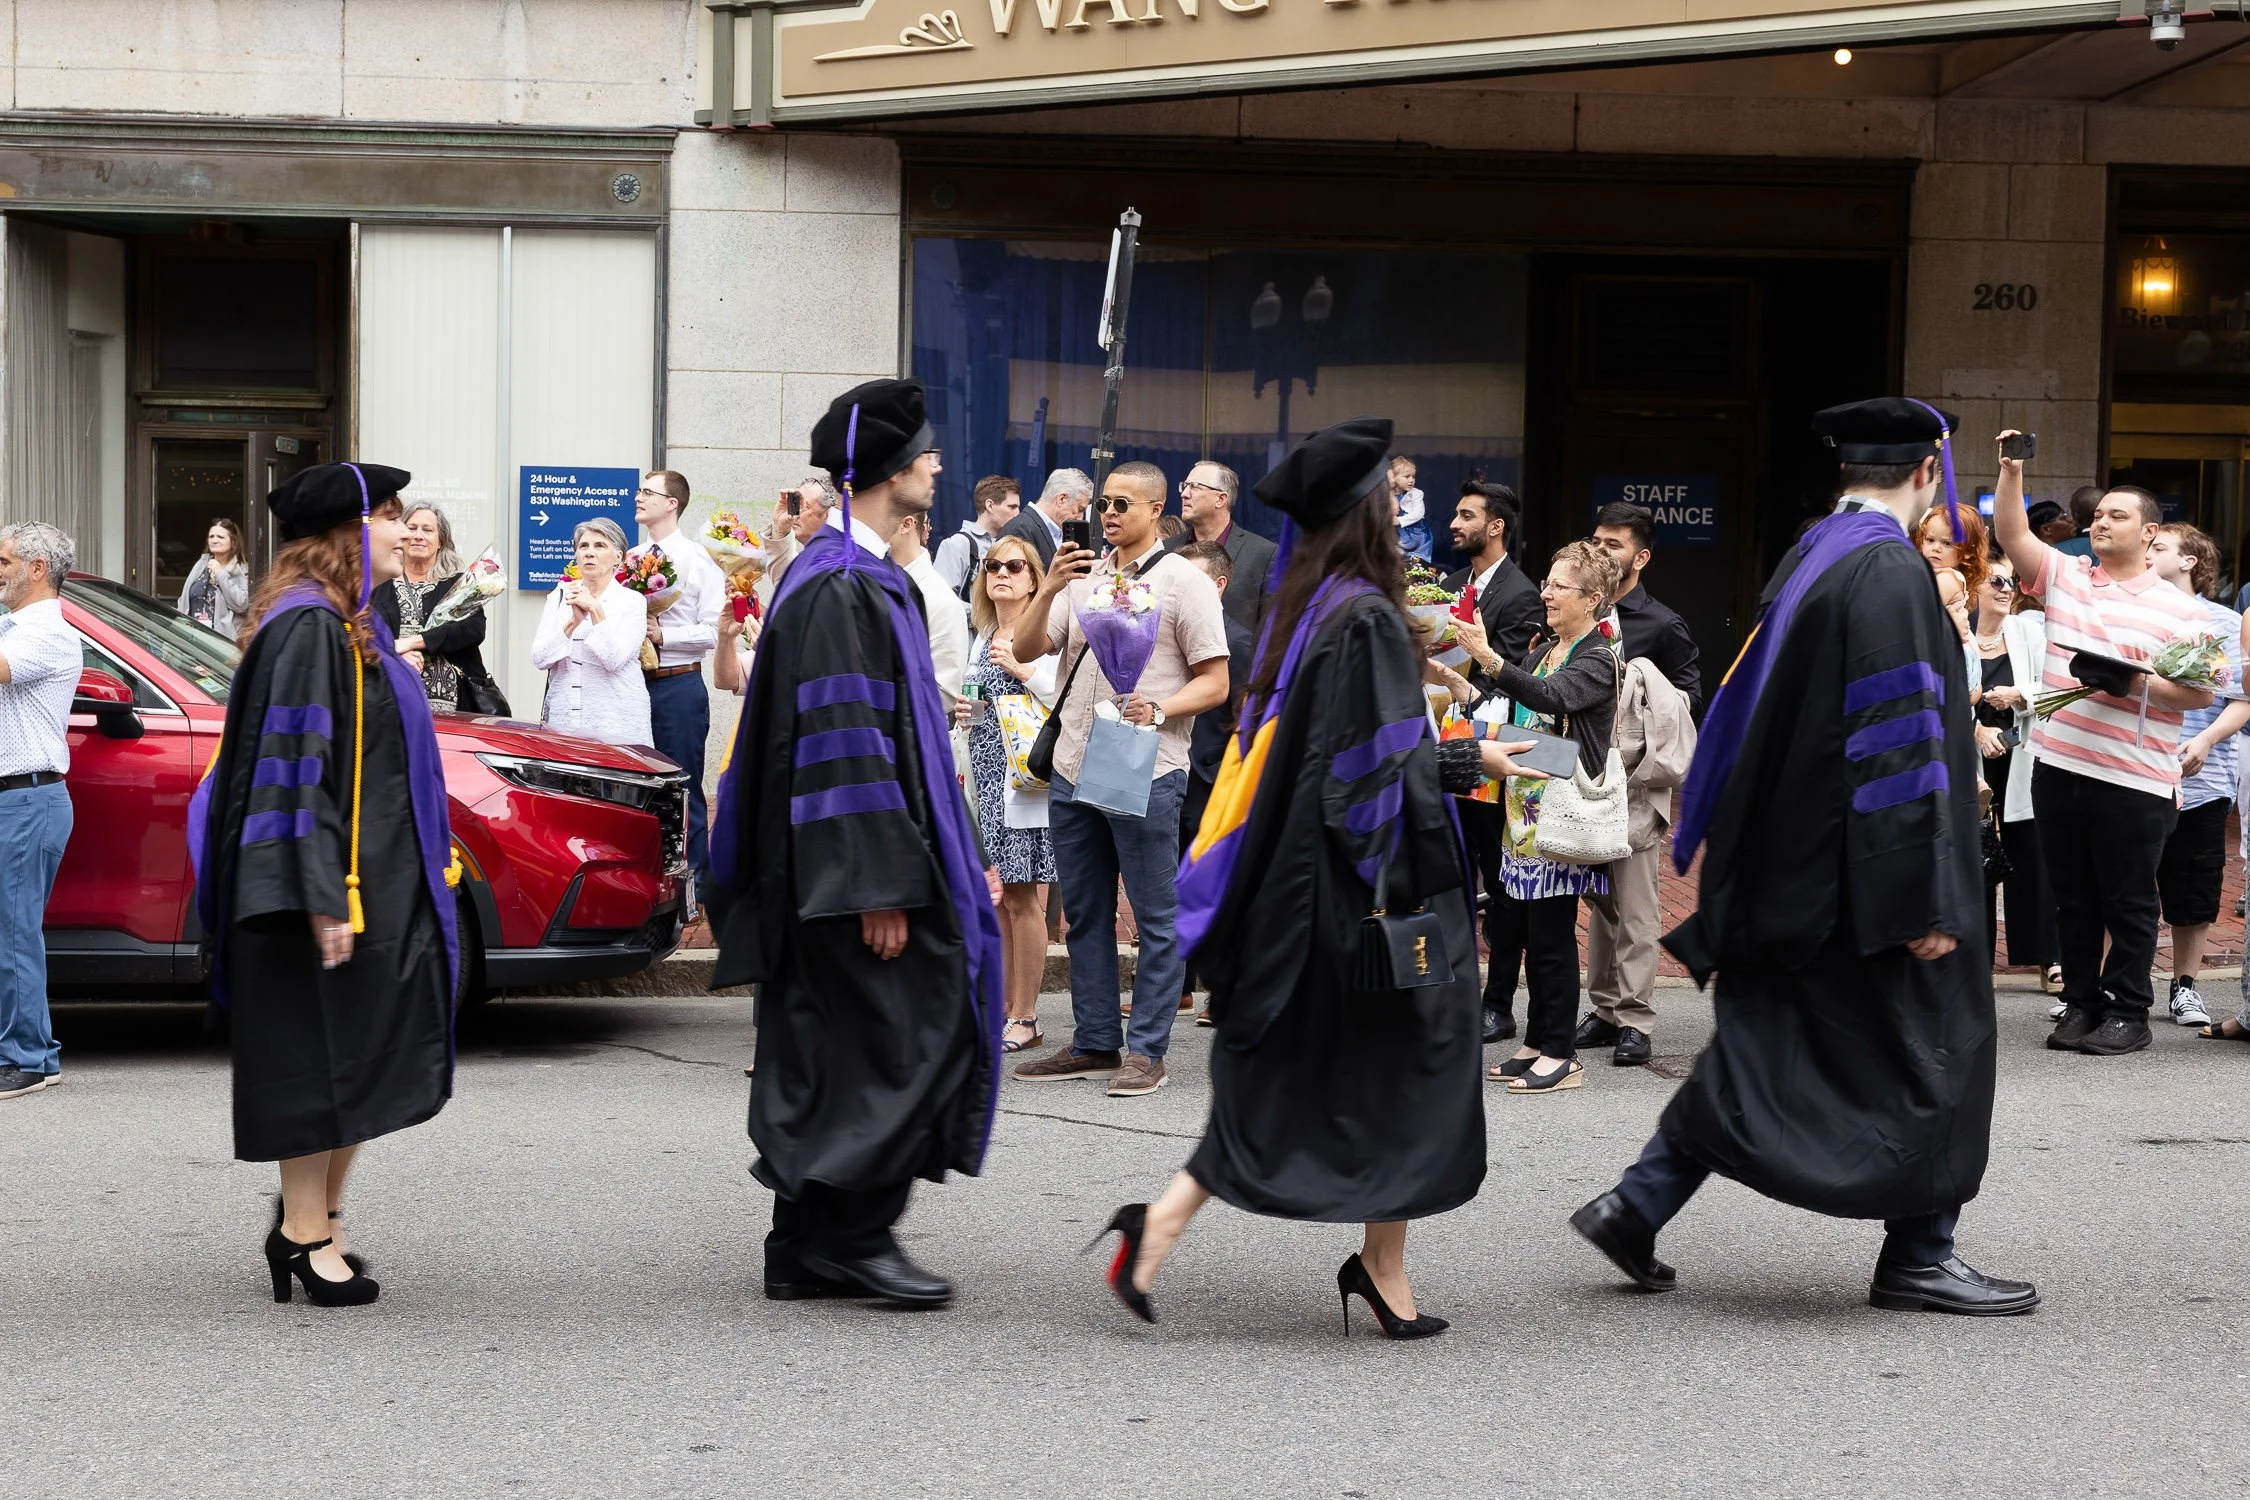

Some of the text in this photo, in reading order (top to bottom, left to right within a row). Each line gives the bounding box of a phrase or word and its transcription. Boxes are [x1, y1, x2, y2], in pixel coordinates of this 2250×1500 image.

[1972, 284, 2037, 311] 260
[530, 475, 576, 484] 24 Hour &
[530, 485, 628, 496] Emergency Access at
[1623, 485, 1688, 503] STAFF
[530, 496, 620, 507] 830 Washington St.
